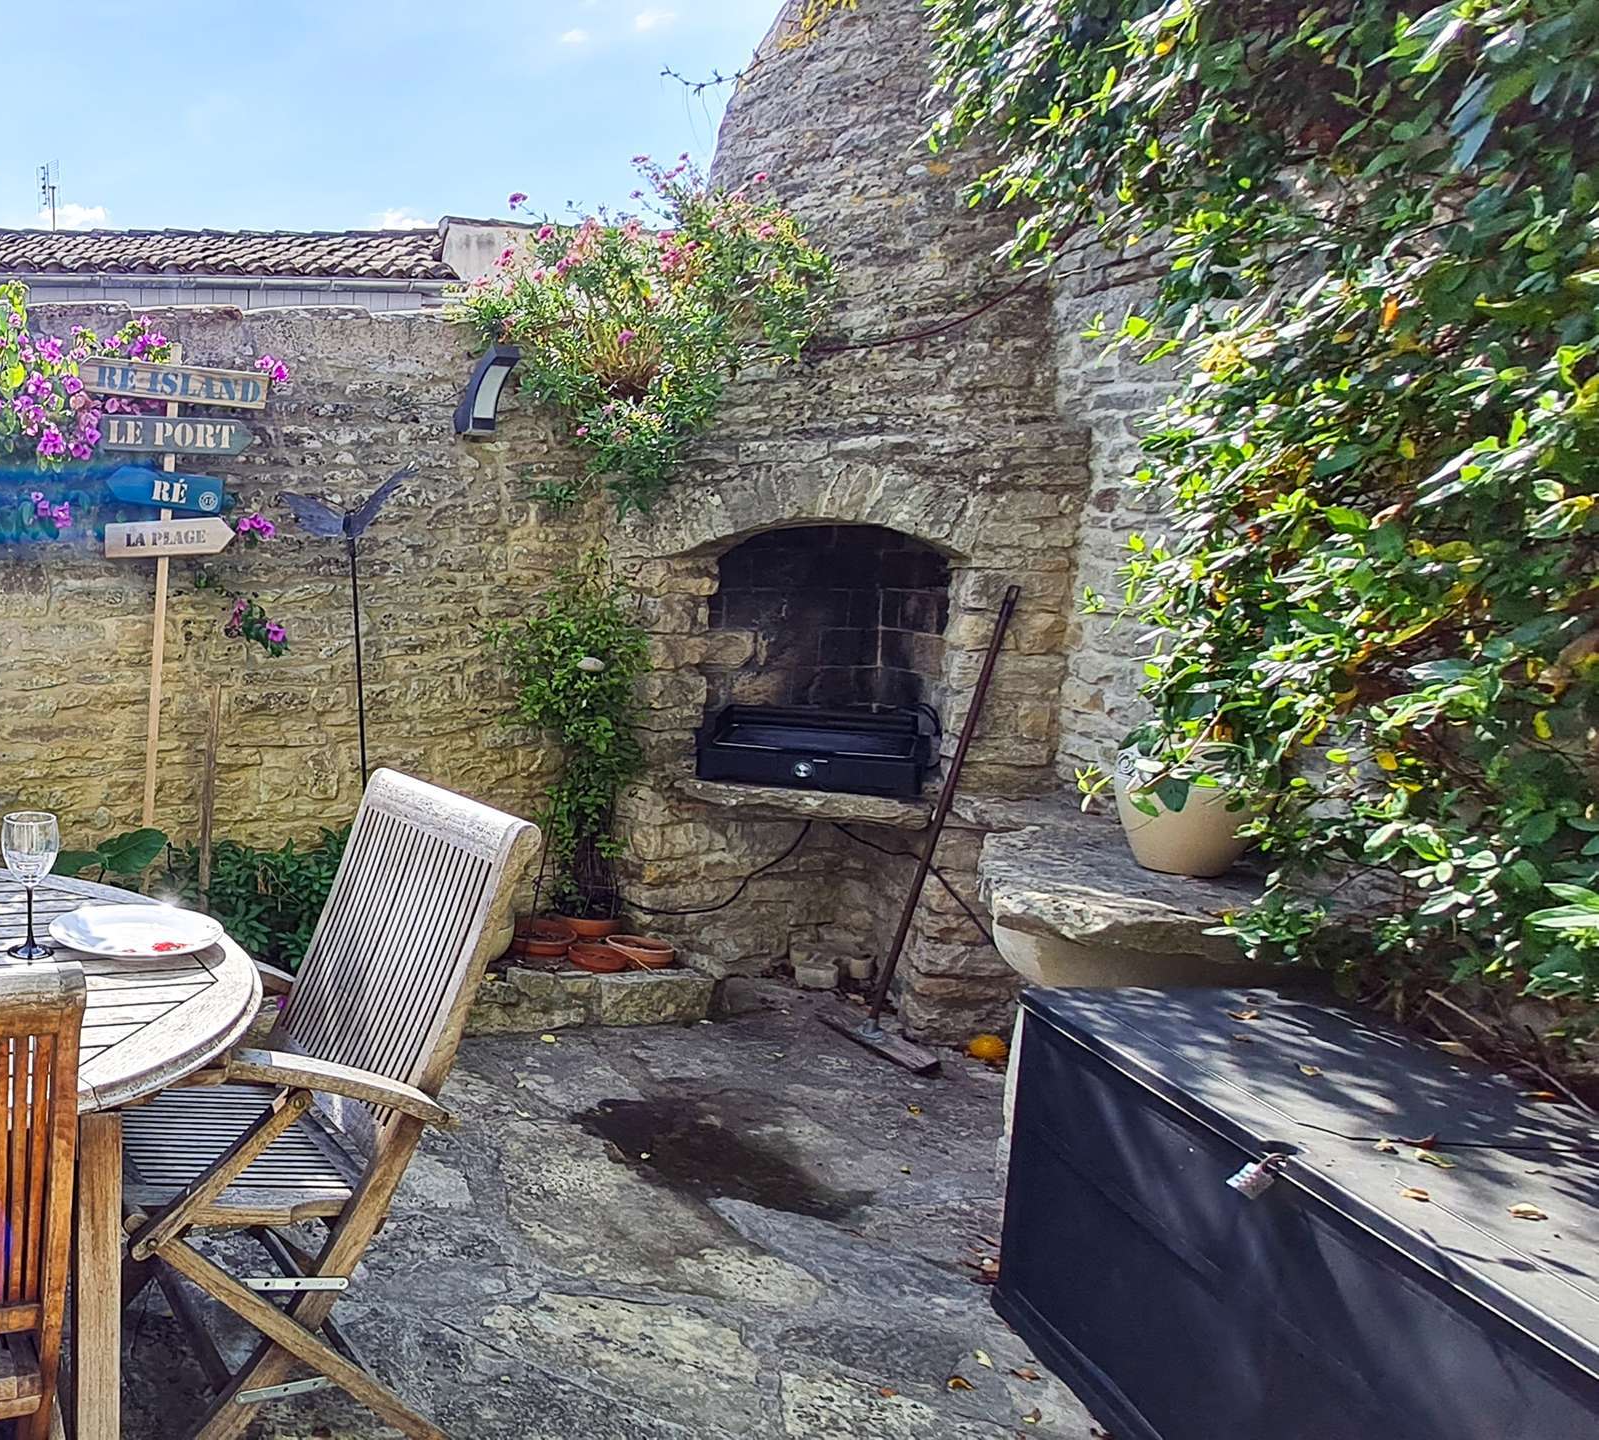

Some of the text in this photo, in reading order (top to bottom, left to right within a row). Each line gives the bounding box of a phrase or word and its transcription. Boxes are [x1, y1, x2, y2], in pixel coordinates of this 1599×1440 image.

[147, 371, 262, 403] ISLAND
[108, 420, 236, 449] LE PORT
[151, 478, 189, 504] RÉ
[125, 529, 207, 548] LA PLAGE
